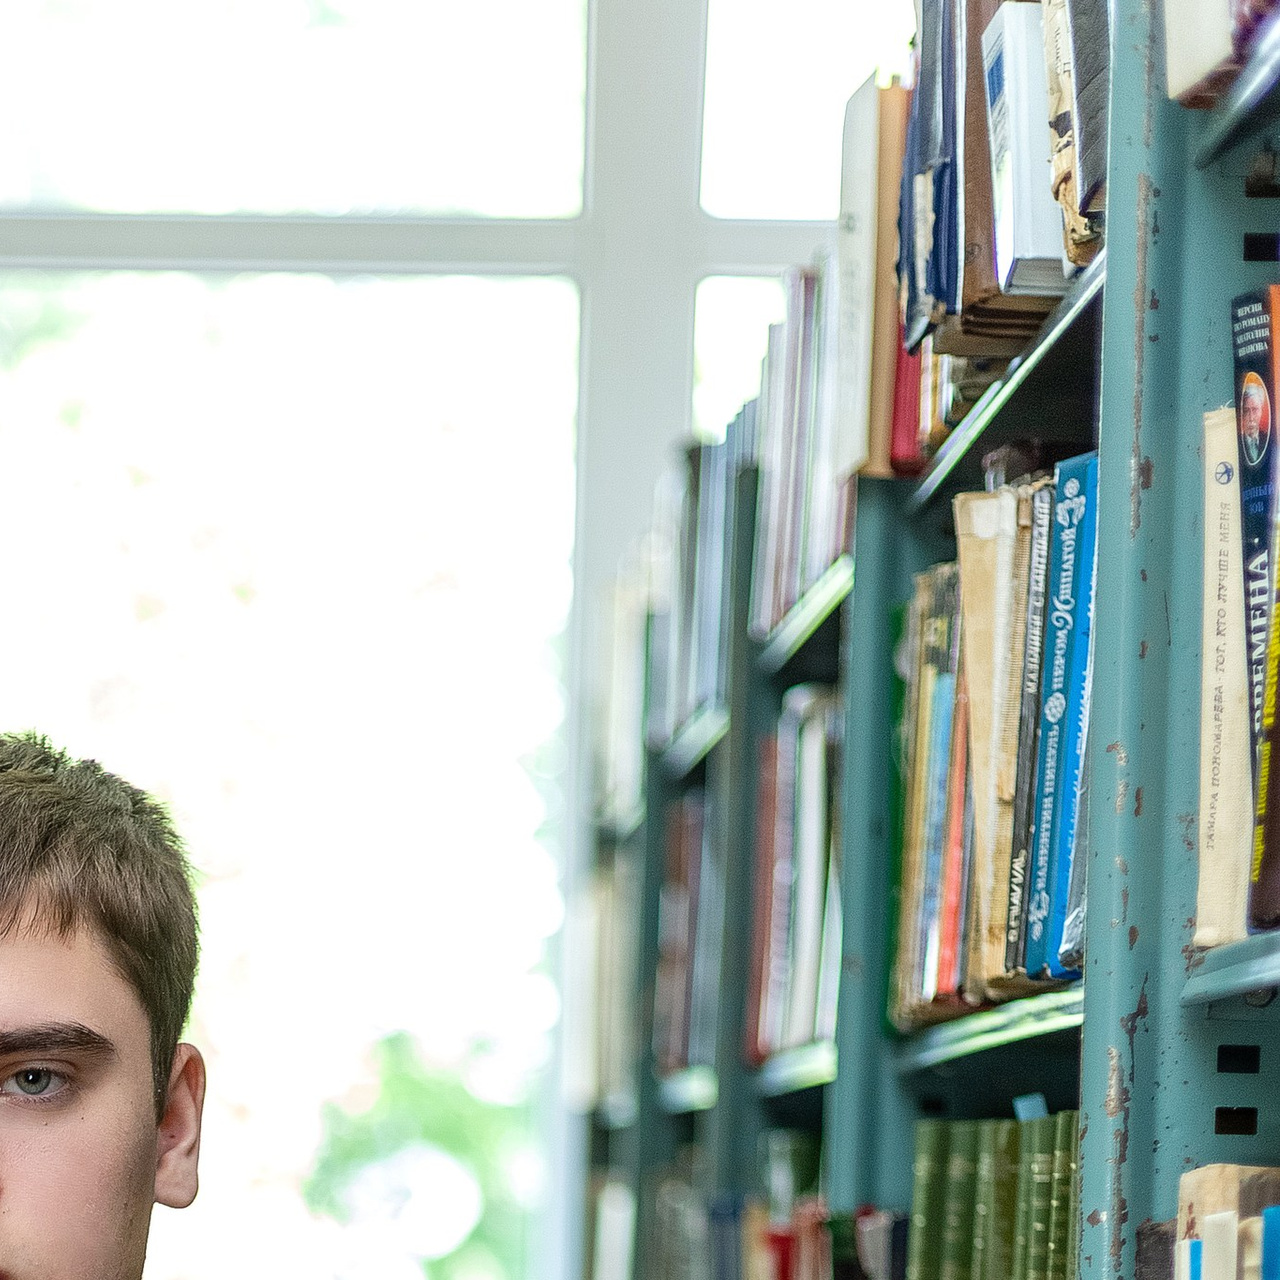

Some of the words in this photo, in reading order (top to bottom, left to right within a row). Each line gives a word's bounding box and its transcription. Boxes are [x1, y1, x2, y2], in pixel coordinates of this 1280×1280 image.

[1238, 302, 1262, 318] ВЕРСИЯ
[1219, 501, 1231, 544] МЕНЯ
[1057, 527, 1075, 601] ШПАГОЙ
[1218, 548, 1229, 604] ЛУЧШЕ
[1216, 608, 1227, 637] КТО
[1052, 628, 1067, 690] ПЕРОМ
[1043, 725, 1059, 794] ПИКУЛЬ
[1212, 684, 1224, 788] ПОНОМАРЕВА
[1206, 791, 1218, 852] ТАМАРА
